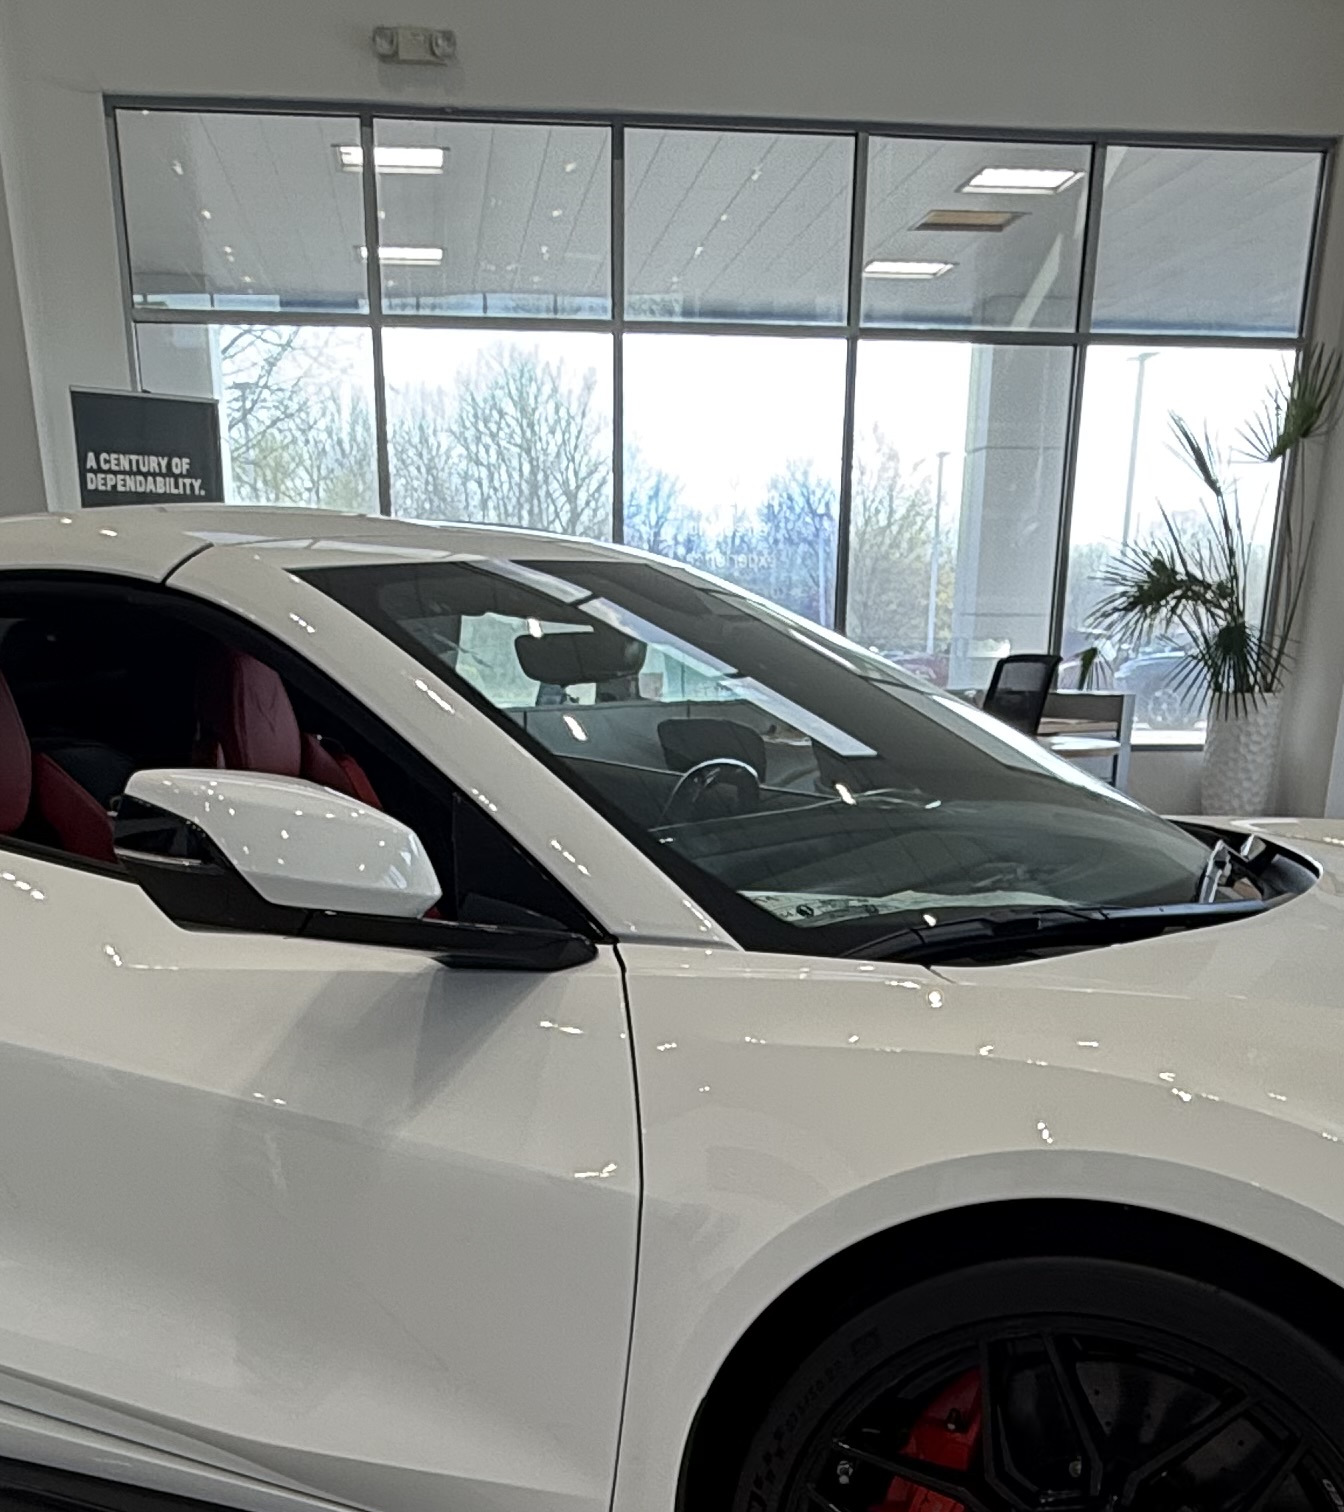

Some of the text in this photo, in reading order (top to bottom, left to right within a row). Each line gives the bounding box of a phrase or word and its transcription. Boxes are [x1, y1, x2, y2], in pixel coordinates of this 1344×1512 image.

[86, 452, 190, 475] A CENTURY OF
[86, 472, 205, 496] DEPENDABILITY.
